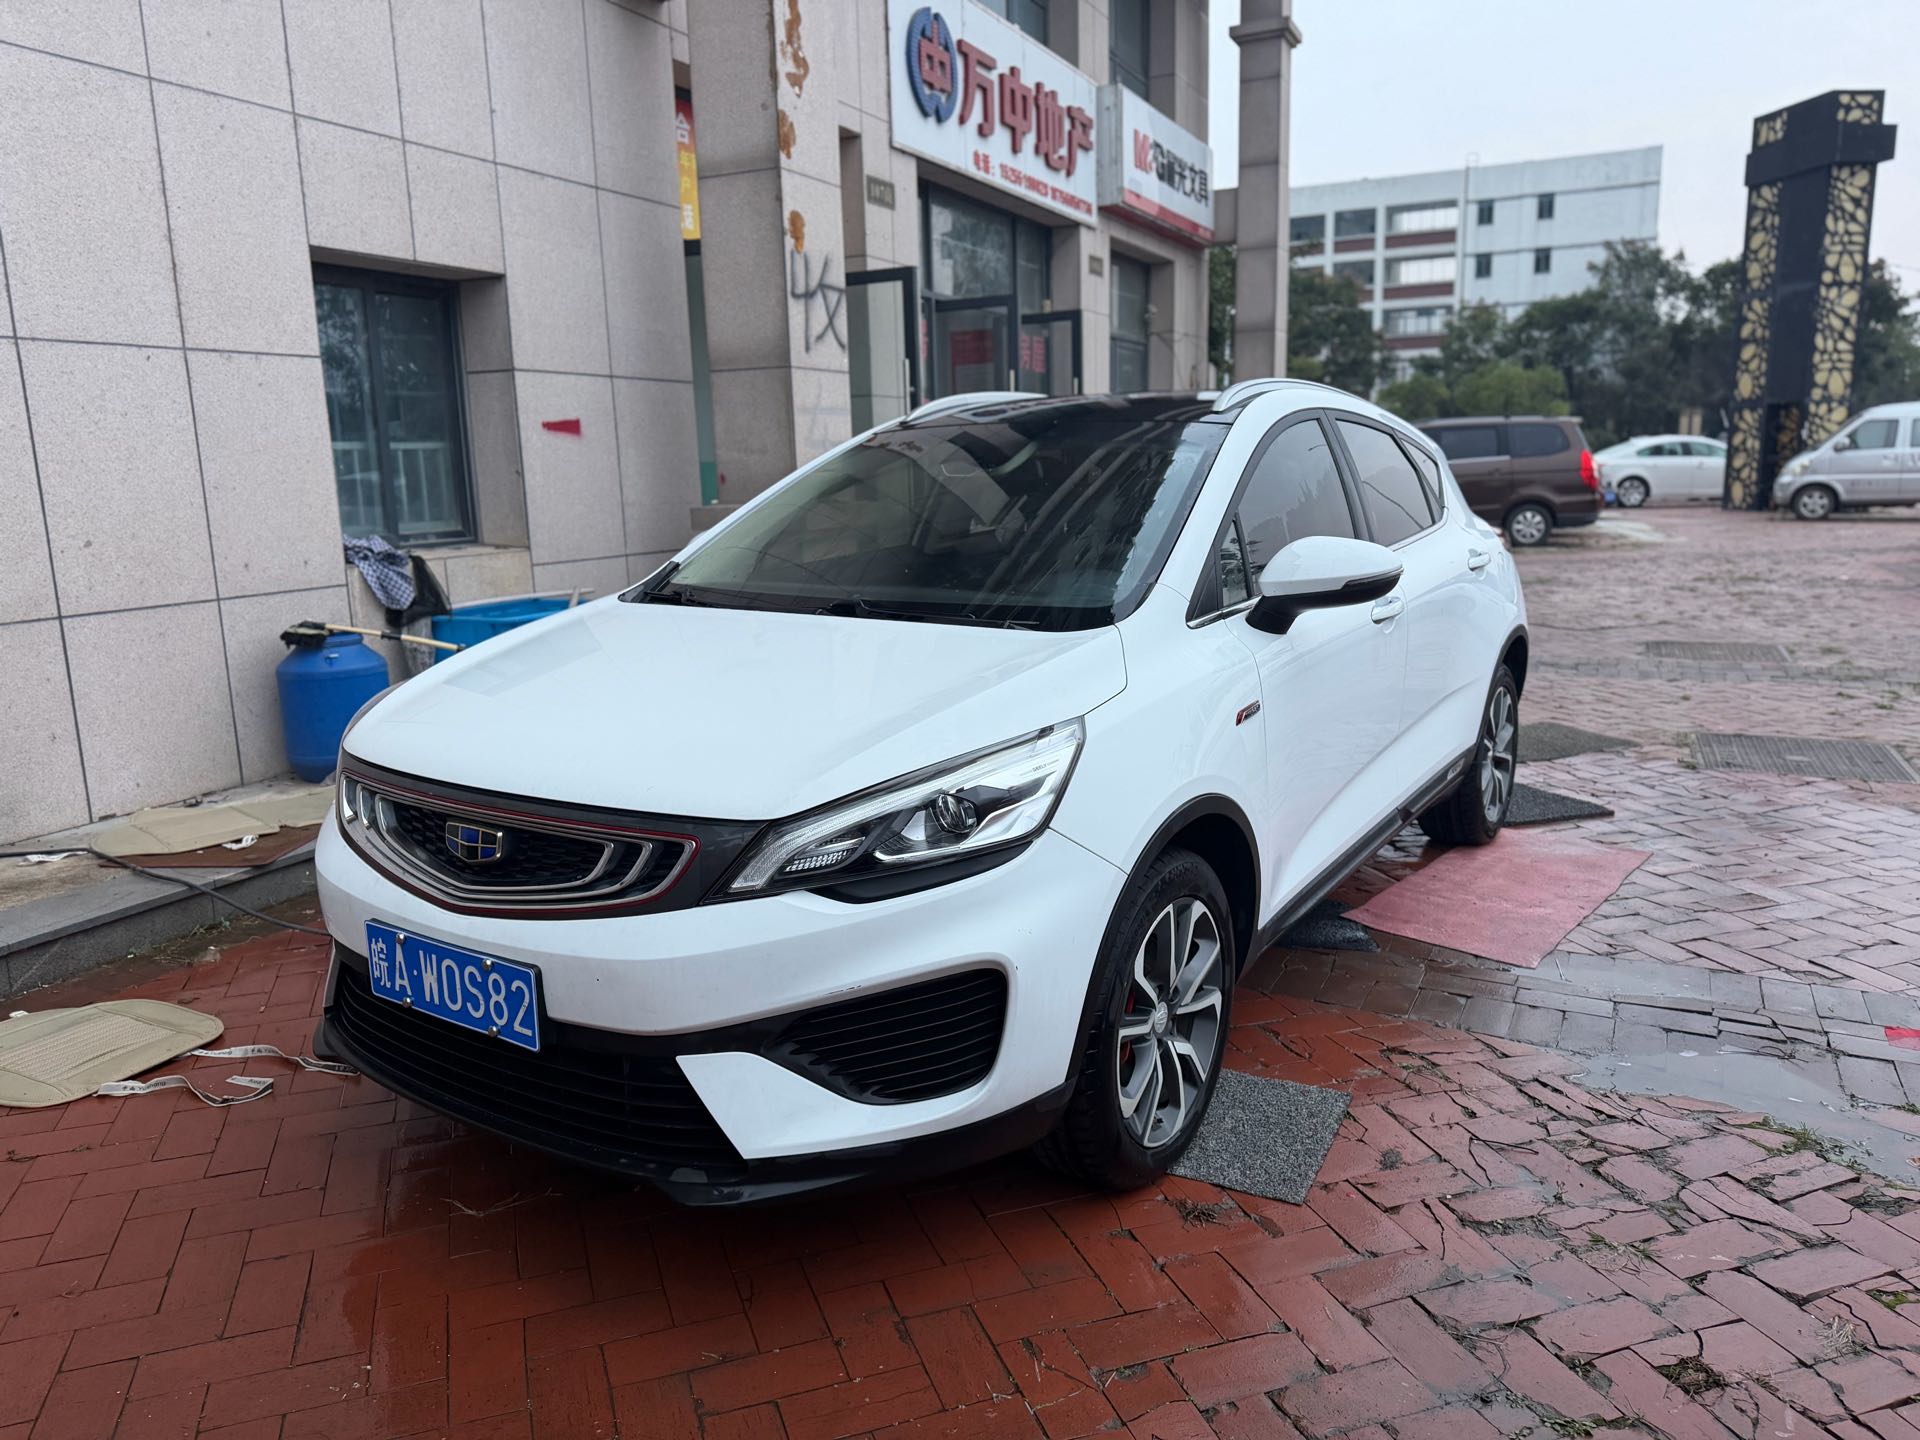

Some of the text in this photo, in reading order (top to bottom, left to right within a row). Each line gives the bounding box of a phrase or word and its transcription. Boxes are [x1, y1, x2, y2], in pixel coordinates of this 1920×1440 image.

[957, 38, 1093, 177] 万中地产
[790, 249, 846, 354] 收
